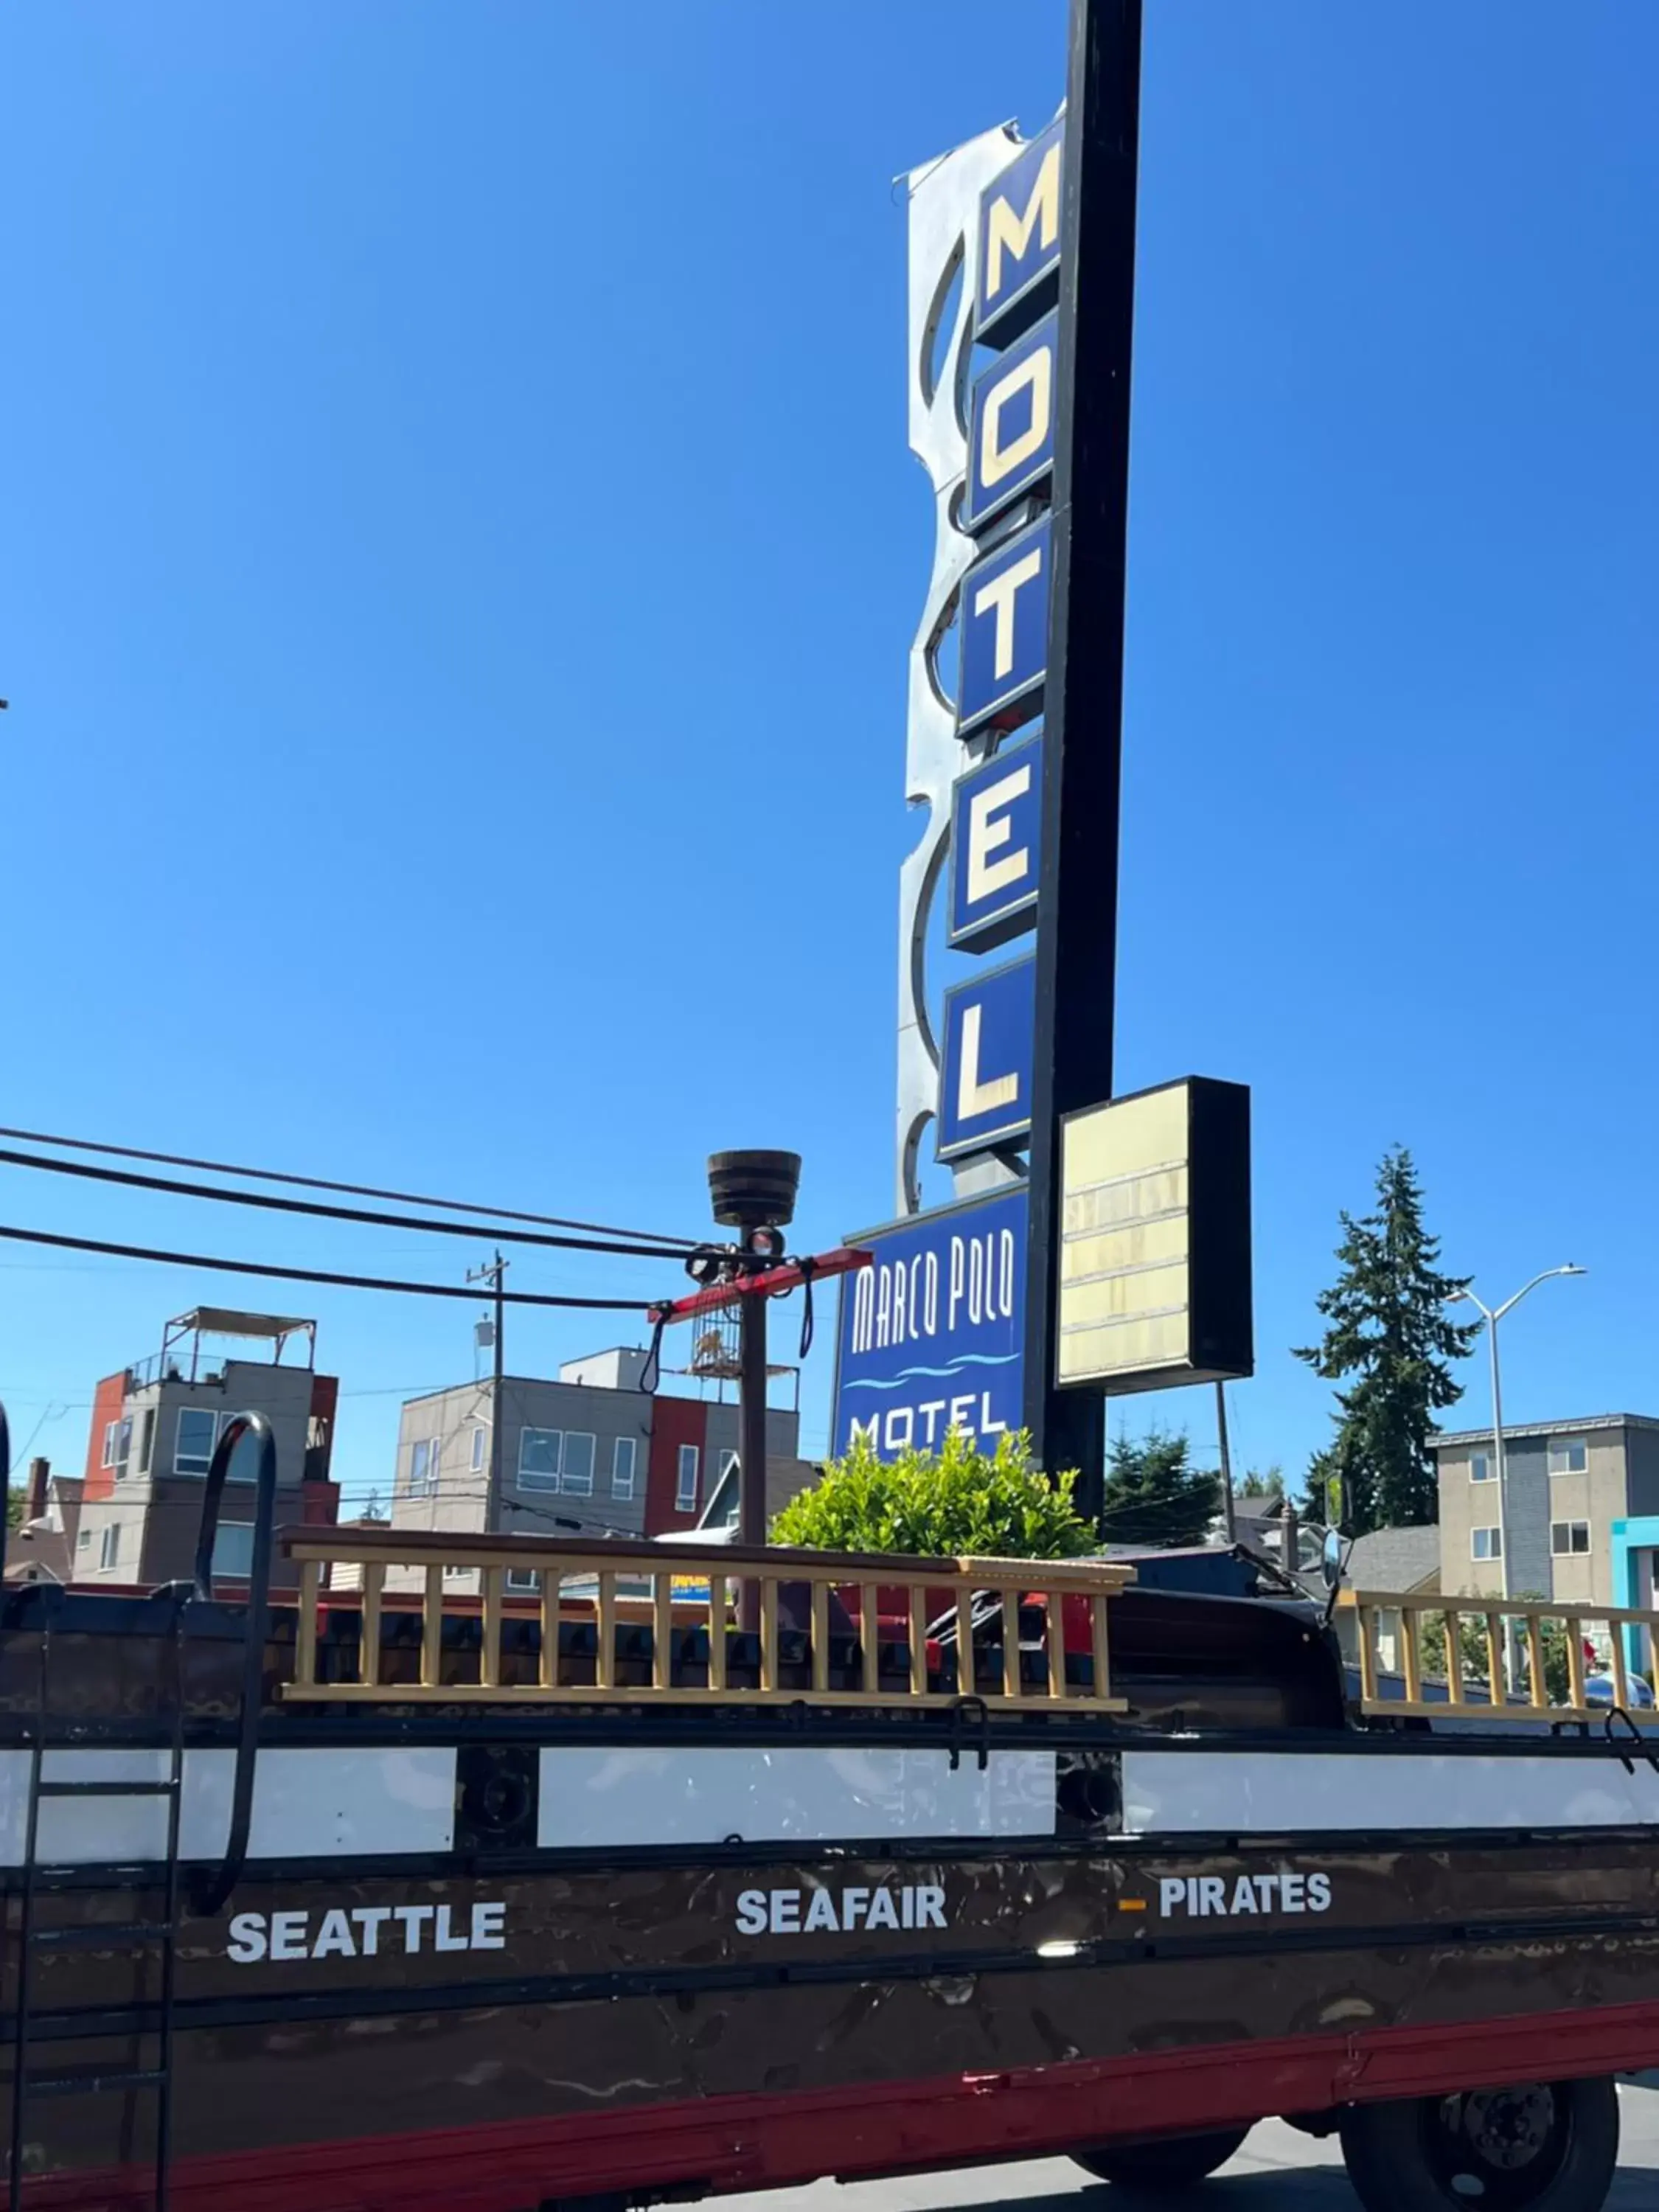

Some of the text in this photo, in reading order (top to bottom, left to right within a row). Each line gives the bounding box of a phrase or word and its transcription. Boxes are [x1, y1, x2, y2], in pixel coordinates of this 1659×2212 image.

[958, 140, 1062, 1121] MOTEL
[852, 1228, 1014, 1354] MARCO POLO
[850, 1391, 1006, 1453] MOTEL
[227, 1874, 1331, 1963] SEATTLE SEAFAIR PIRATES
